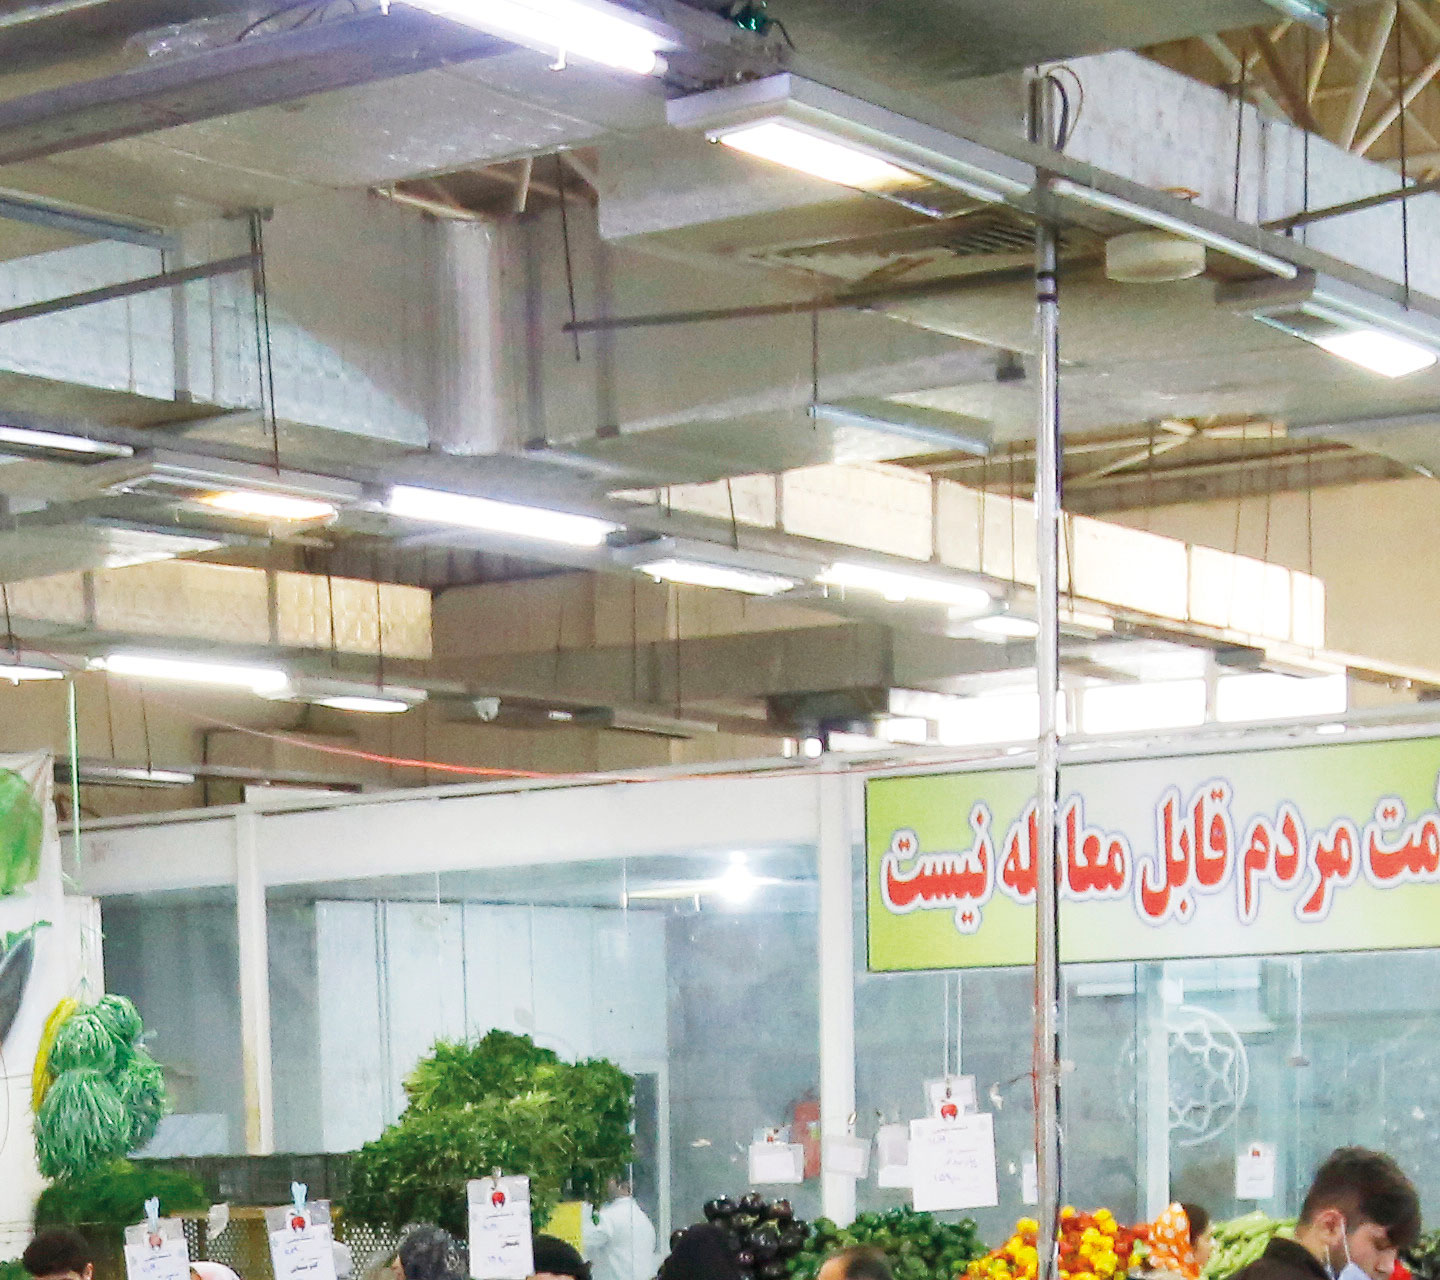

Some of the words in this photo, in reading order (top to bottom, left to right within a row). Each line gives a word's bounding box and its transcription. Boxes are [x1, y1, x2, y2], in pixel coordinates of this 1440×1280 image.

[881, 802, 995, 934] نیست
[997, 796, 1134, 903] معاله
[1135, 779, 1234, 924] قابل
[1242, 802, 1359, 924] مردم
